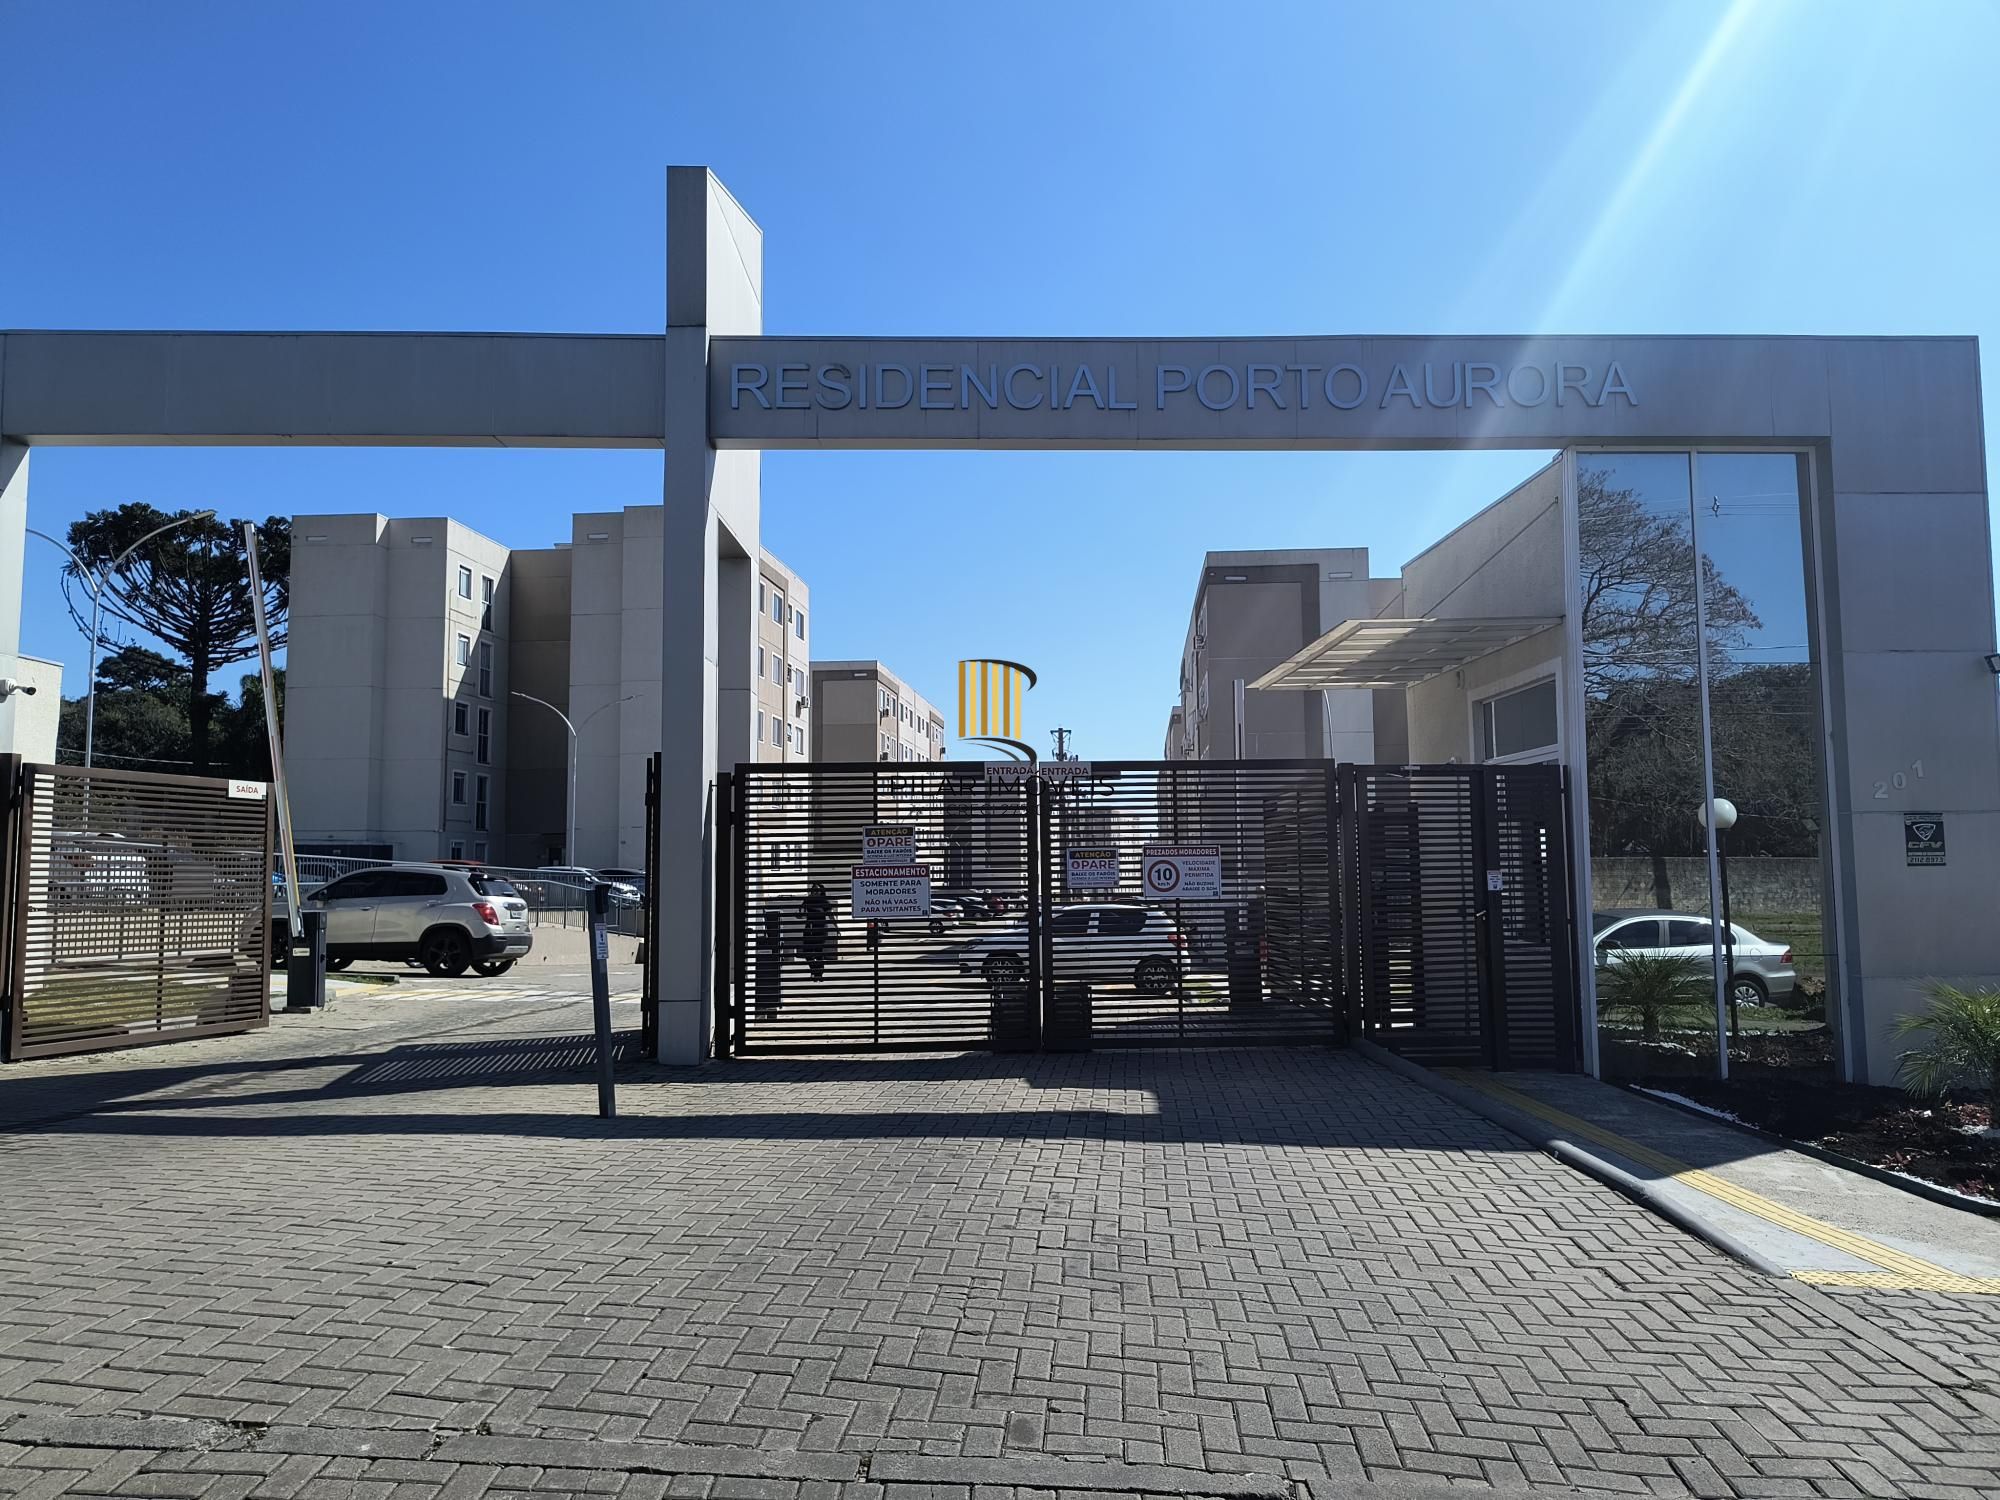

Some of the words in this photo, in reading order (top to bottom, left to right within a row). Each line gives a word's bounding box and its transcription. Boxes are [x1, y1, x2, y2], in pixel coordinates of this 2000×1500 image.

[730, 363, 1138, 410] RESIDENCIAL
[1156, 361, 1368, 411] PORTO
[1379, 360, 1638, 409] AURORA
[986, 766, 1034, 776] ENTRADA
[1041, 767, 1089, 776] ENTRADA
[1873, 760, 1925, 799] 201
[236, 785, 258, 794] SAÍDA
[855, 867, 927, 877] ESTACIONAMENTO
[1154, 867, 1173, 881] 10
[860, 880, 899, 888] SOMENTE
[900, 879, 922, 887] PARA
[865, 888, 917, 896] MORADORES
[864, 898, 881, 906] NÃO
[881, 905, 922, 913] VISITANTES
